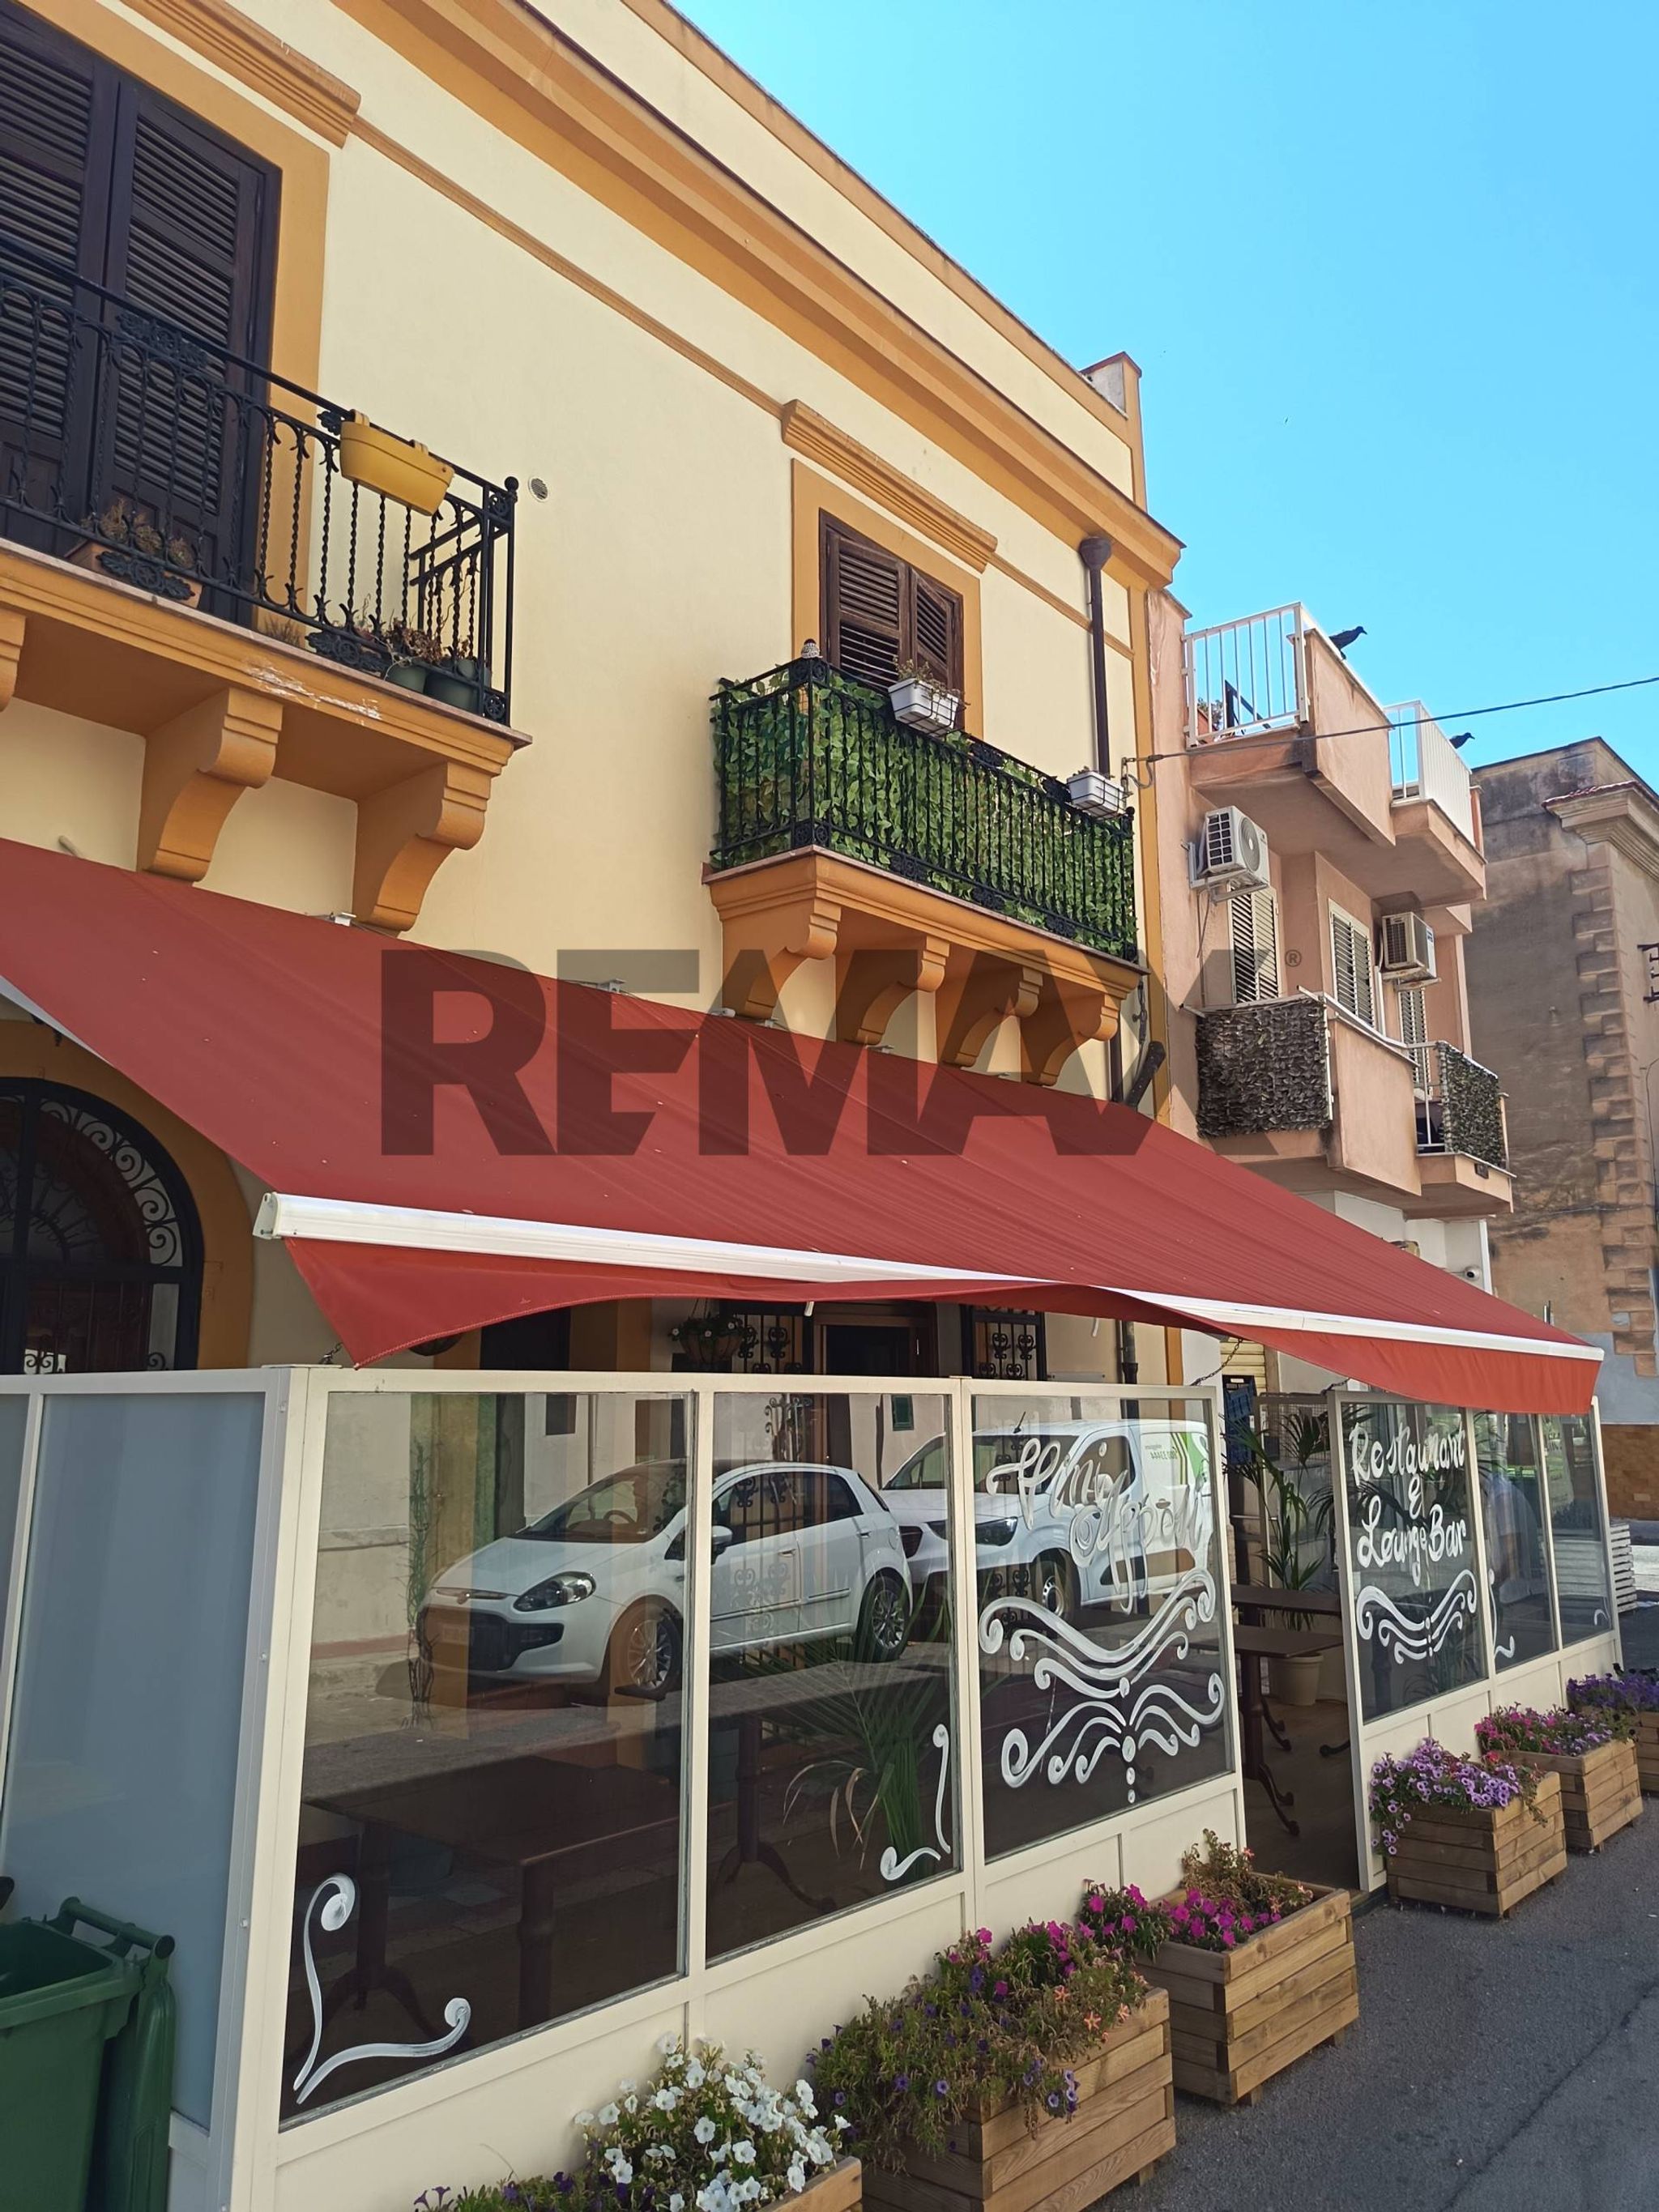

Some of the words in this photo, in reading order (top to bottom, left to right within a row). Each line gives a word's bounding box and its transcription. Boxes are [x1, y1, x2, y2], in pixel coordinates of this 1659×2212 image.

[1349, 1421, 1466, 1486] Restaurant
[1357, 1495, 1427, 1587] Lounge
[1428, 1503, 1467, 1562] Bar
